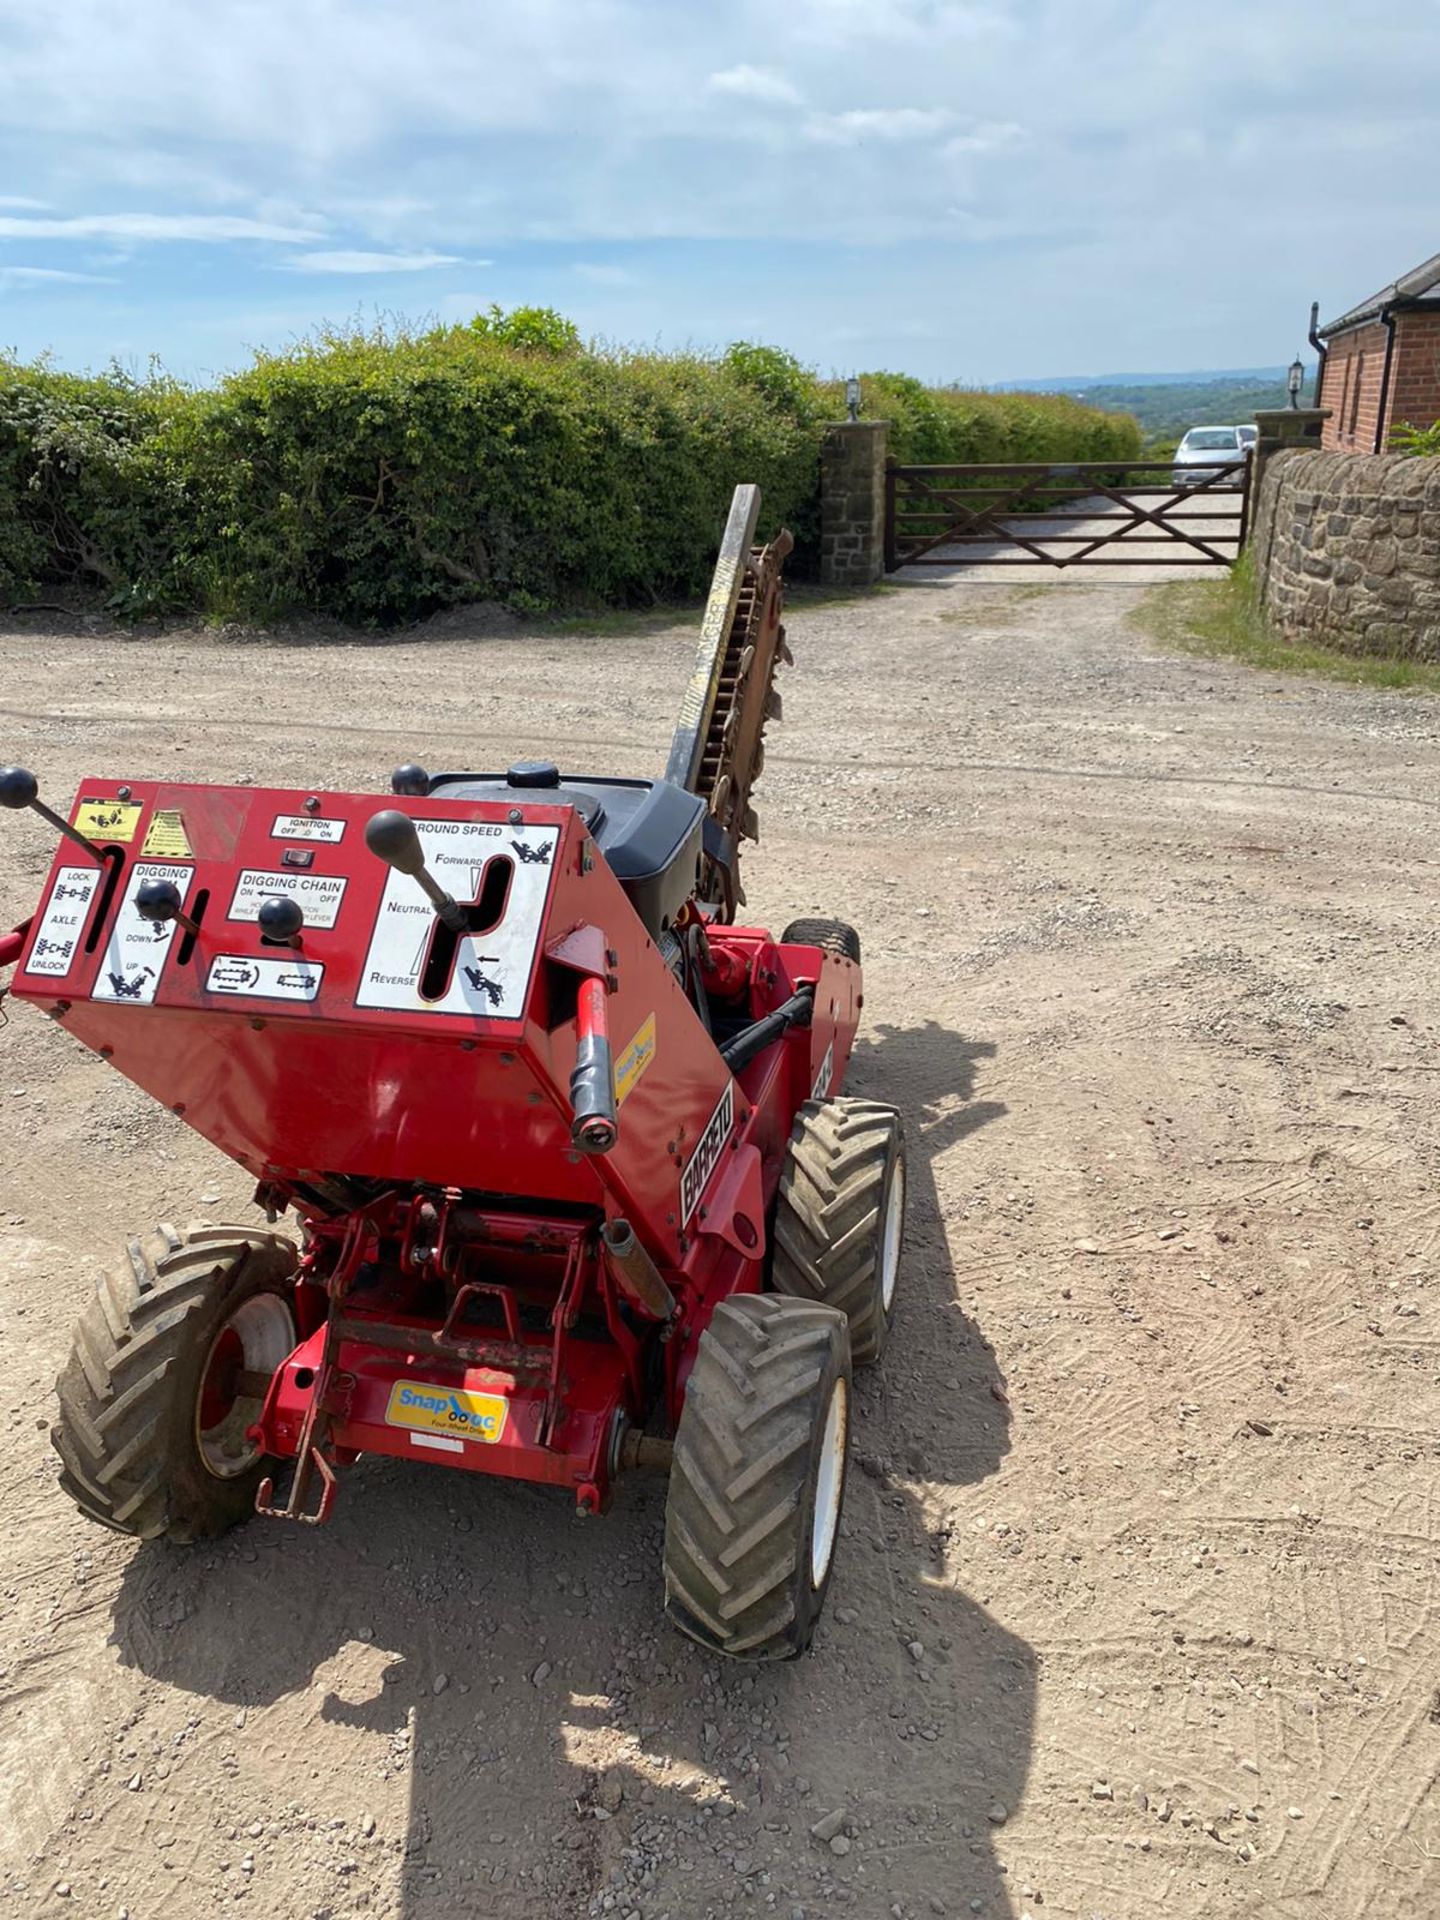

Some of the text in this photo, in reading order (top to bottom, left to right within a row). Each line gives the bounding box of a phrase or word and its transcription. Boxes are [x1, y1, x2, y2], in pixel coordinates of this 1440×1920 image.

[290, 819, 330, 829] IGNITION
[463, 827, 502, 837] SPEED
[435, 854, 483, 866] FORWARD
[67, 872, 90, 881] LOCK
[136, 866, 188, 879] DIGGING
[243, 875, 342, 893] DIGGING CHAIN
[240, 888, 337, 903] ON OFF
[387, 902, 432, 915] NEUTRAL
[51, 915, 78, 926] AXLE
[126, 934, 152, 943] DOWN
[31, 960, 66, 970] UNLOCK
[126, 962, 139, 970] UP
[370, 972, 415, 986] REVERSE
[683, 1086, 732, 1216] BARRETO
